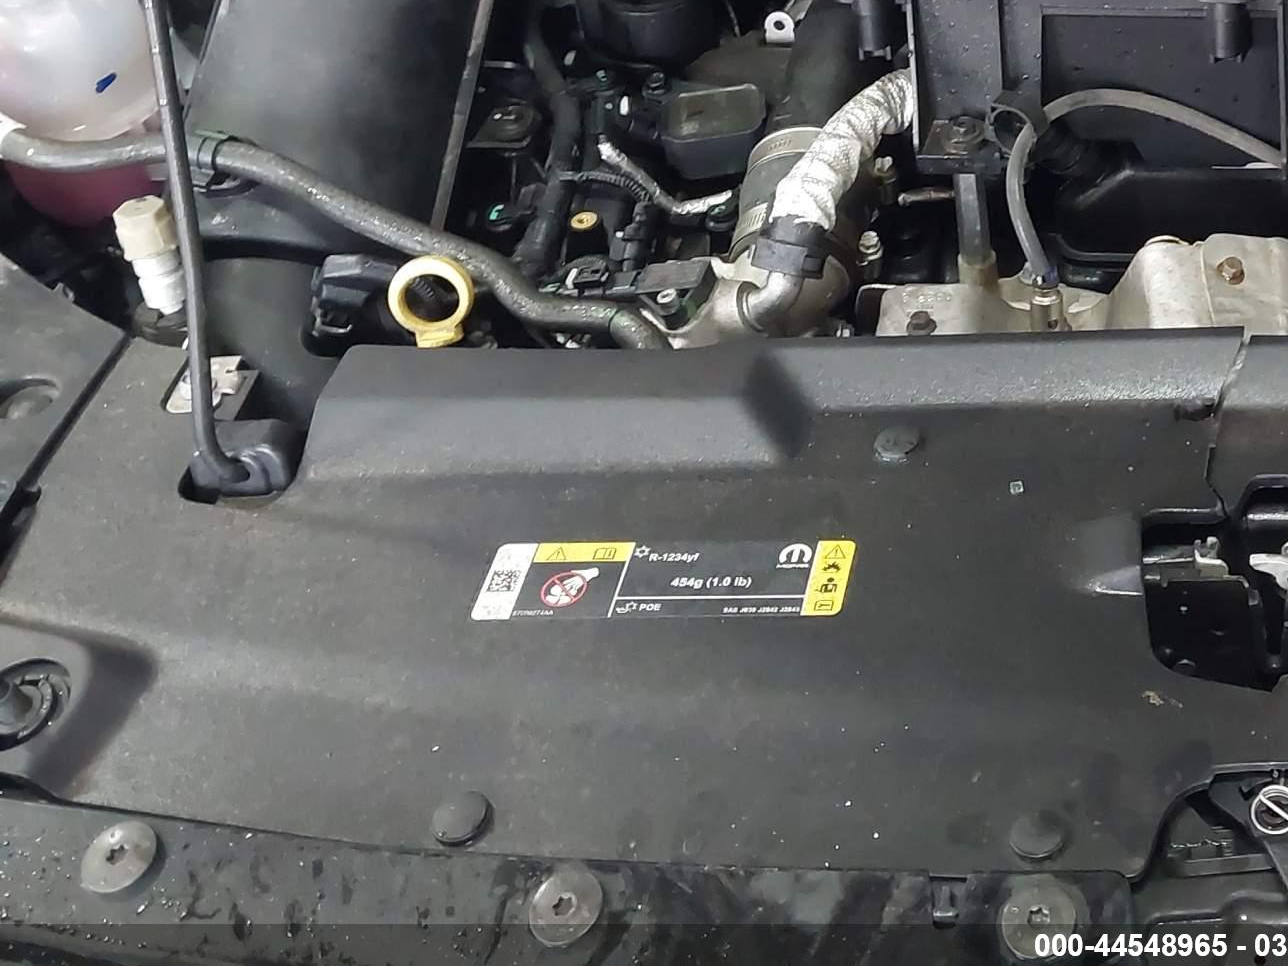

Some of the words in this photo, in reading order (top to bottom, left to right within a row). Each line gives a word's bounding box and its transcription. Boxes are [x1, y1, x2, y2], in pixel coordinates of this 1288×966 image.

[648, 552, 701, 563] R-1234yf
[670, 577, 704, 590] 454g
[706, 576, 732, 589] (1.0
[733, 576, 753, 589] lb)
[638, 602, 662, 612] POE
